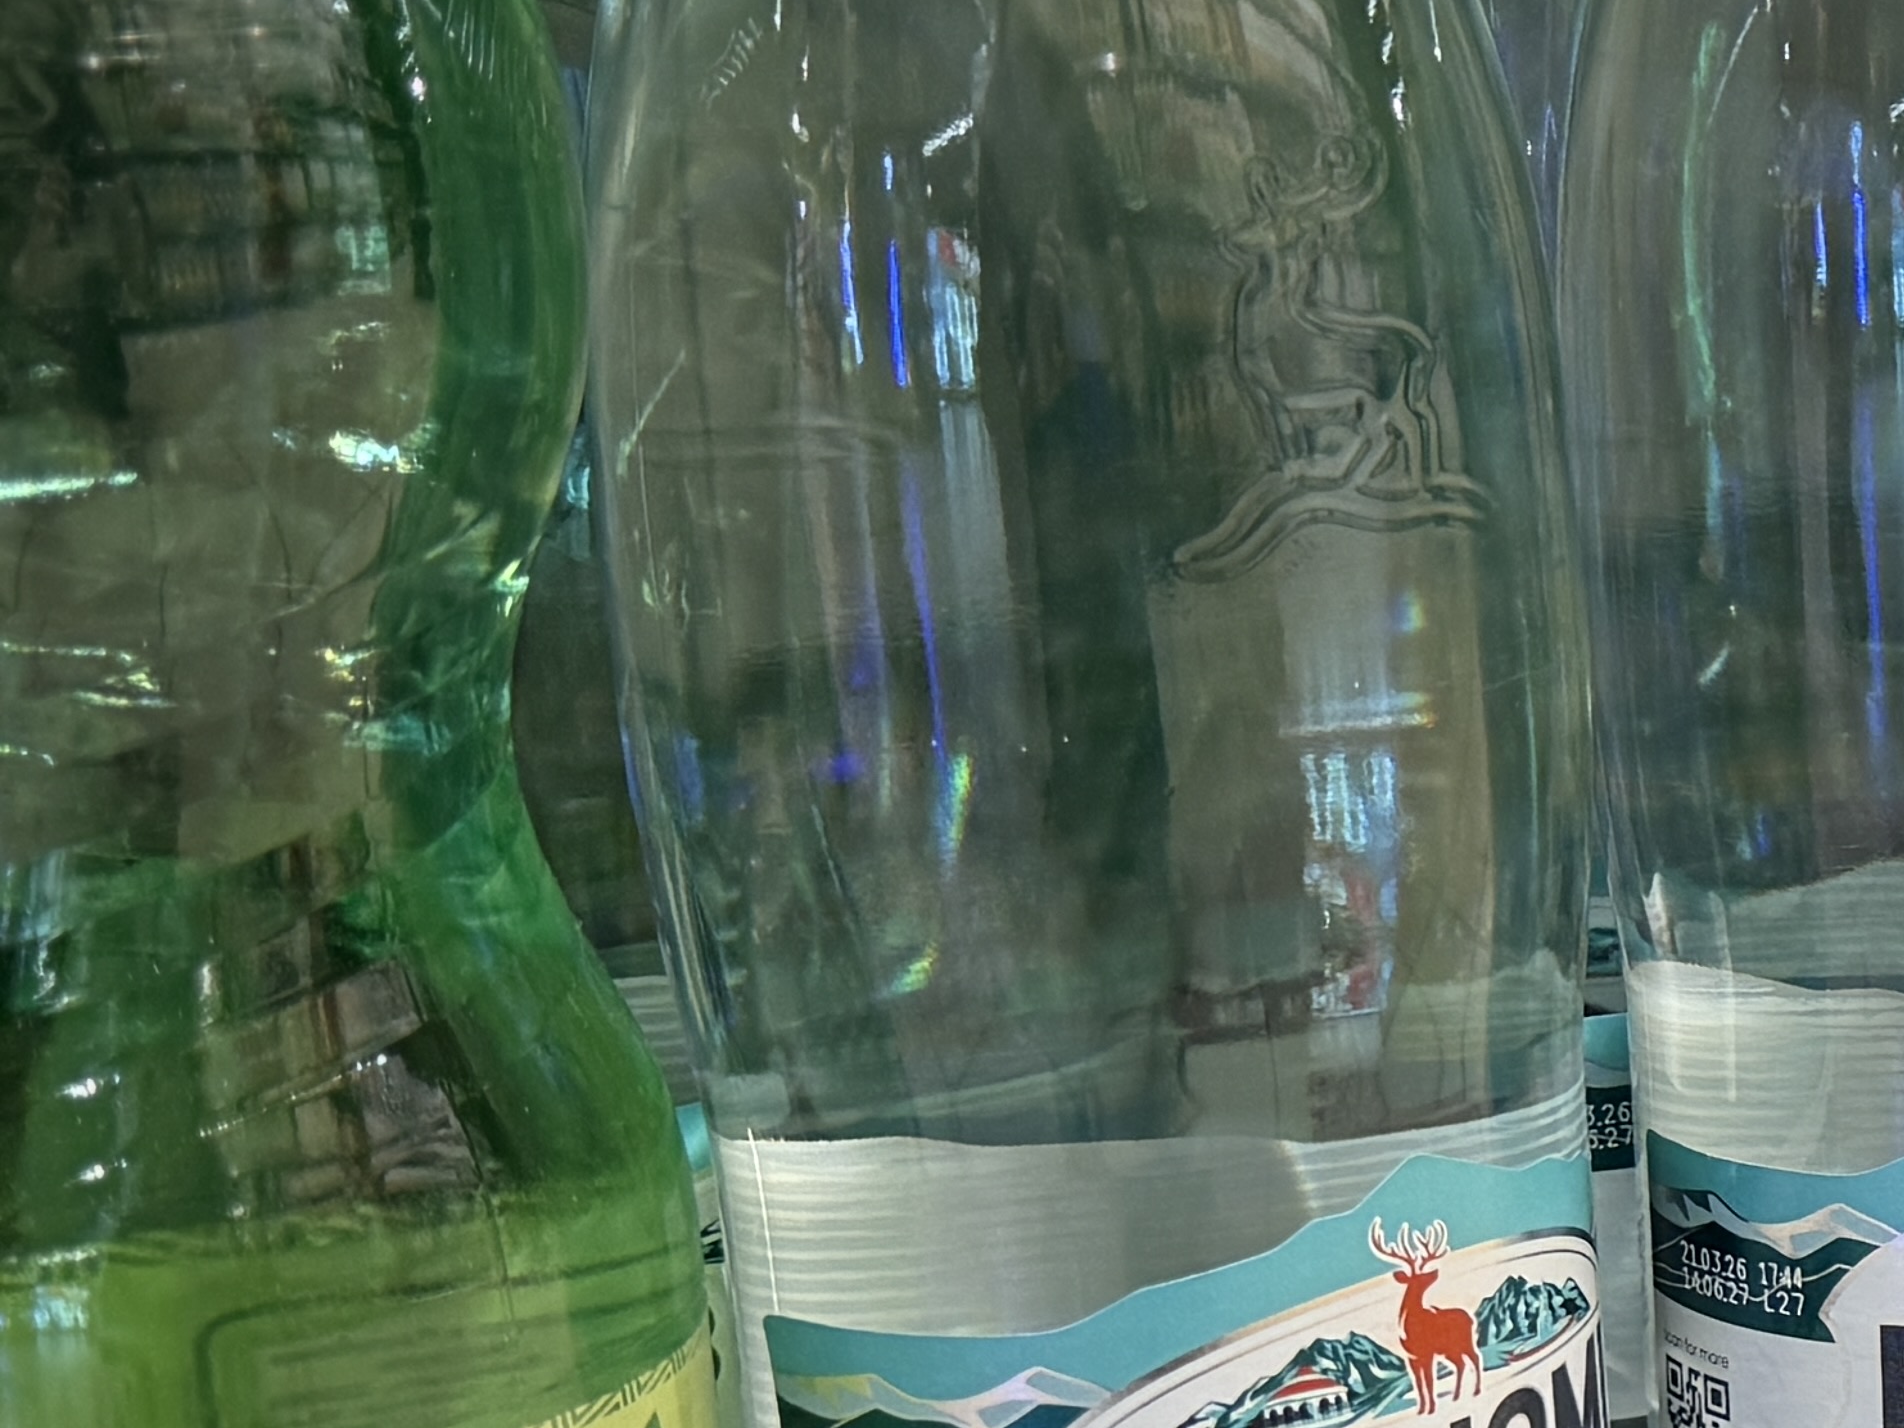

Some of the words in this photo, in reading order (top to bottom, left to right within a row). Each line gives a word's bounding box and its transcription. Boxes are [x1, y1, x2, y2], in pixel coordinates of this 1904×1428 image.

[1680, 1240, 1748, 1281] 21.03.26
[1682, 1267, 1750, 1306] 14.06.27
[1763, 1289, 1805, 1316] L27
